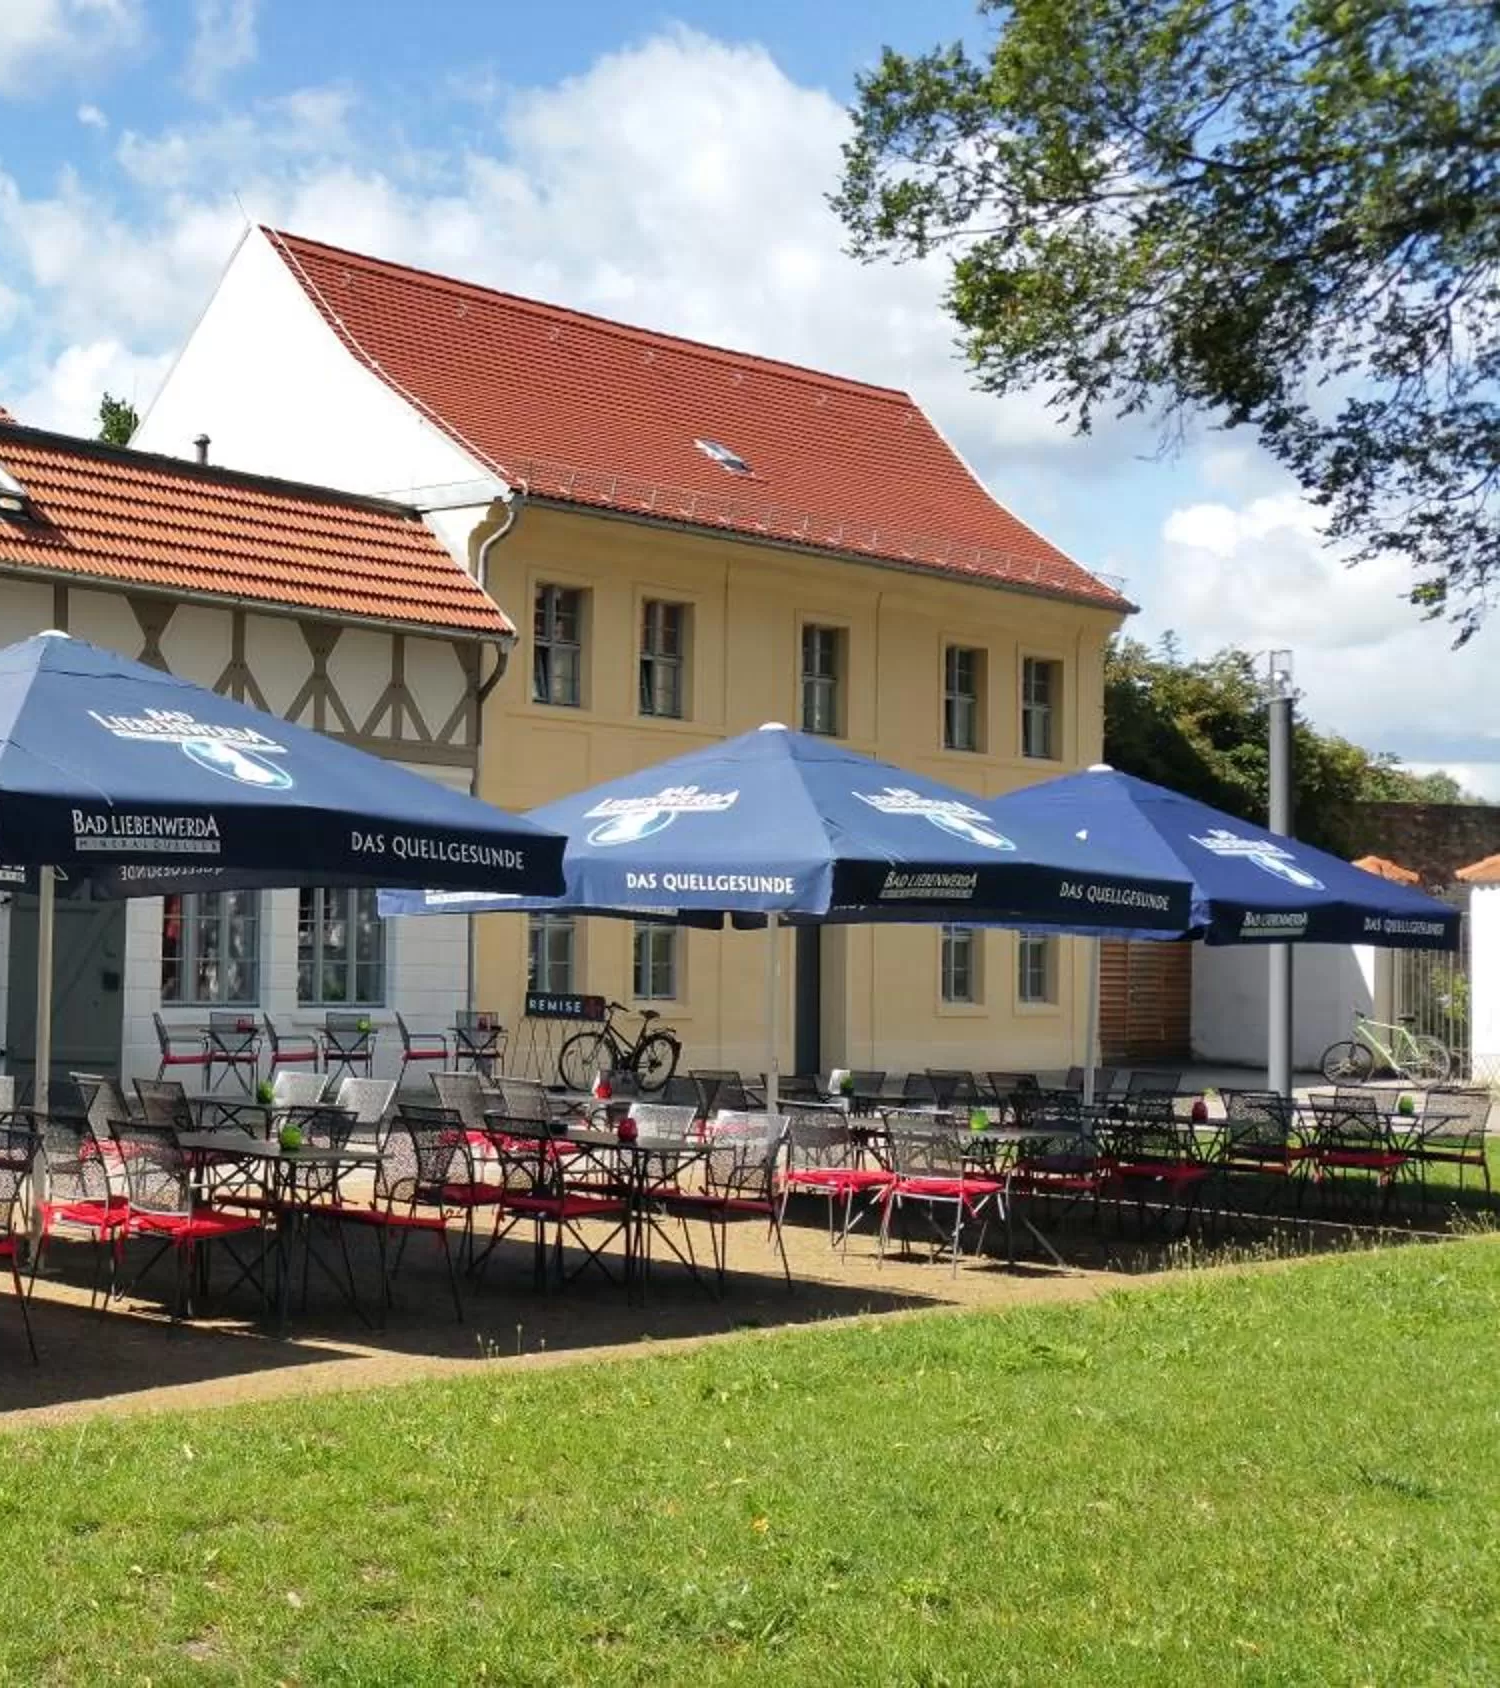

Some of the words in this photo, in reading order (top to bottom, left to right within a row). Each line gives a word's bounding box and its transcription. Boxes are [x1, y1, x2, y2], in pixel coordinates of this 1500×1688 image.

[71, 809, 107, 834] BAD
[111, 813, 219, 837] LIEBENWERDA
[351, 831, 385, 853] DAS
[392, 836, 525, 870] QUELLGESUNDE
[626, 873, 657, 889] DAS
[663, 873, 796, 894] QUELLGESUNDE
[1060, 881, 1083, 899] DAS
[1086, 885, 1170, 911] QUELLGESUNDE
[528, 999, 582, 1013] REMISE
